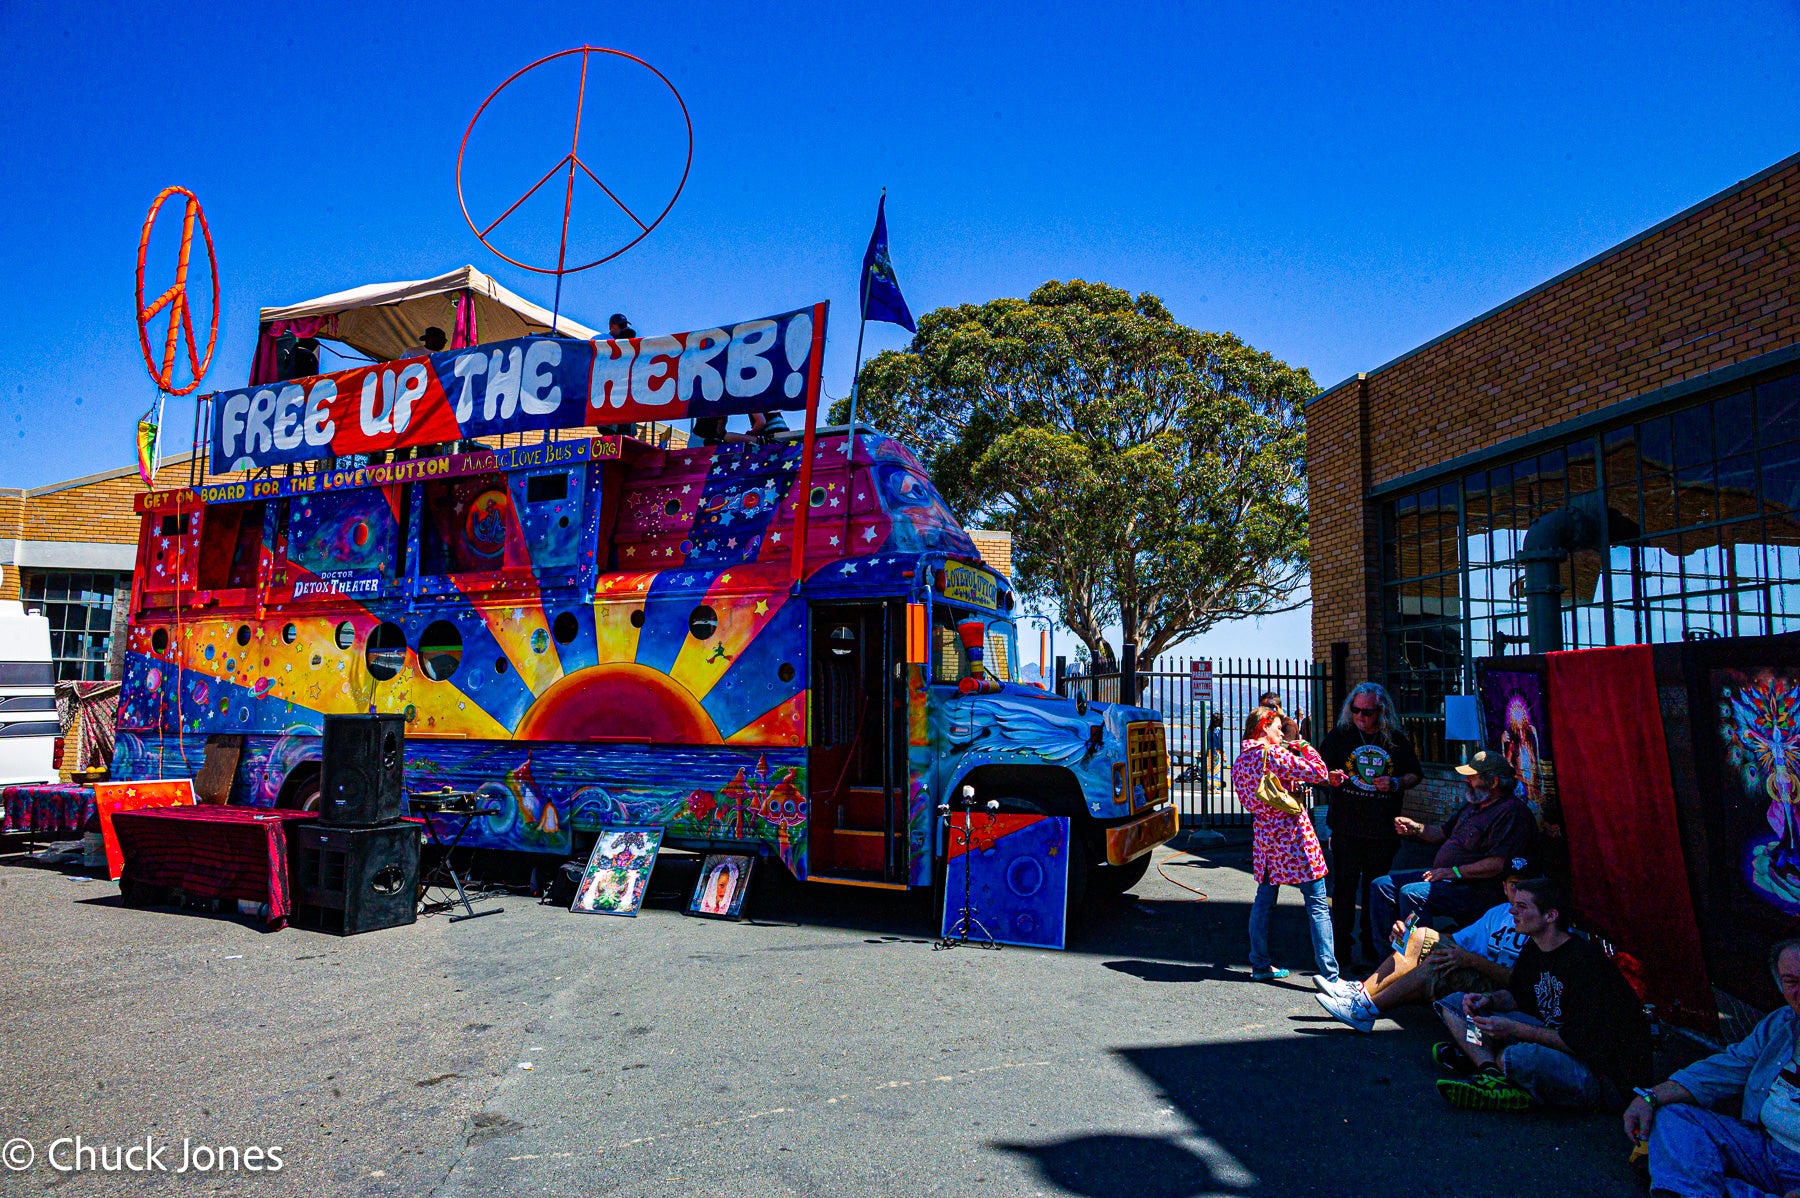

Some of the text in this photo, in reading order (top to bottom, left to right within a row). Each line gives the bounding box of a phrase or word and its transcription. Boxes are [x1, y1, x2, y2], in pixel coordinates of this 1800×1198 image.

[222, 312, 813, 458] FREE UP THE HERB!
[143, 491, 170, 509] GET
[175, 490, 194, 504] ON
[200, 483, 245, 502] BOARD
[253, 480, 279, 498] FOR
[290, 475, 316, 493] THE
[323, 457, 450, 488] LOVEVOLUTION
[293, 579, 379, 598] DETOX THEATER
[321, 570, 354, 580] DOCTOR
